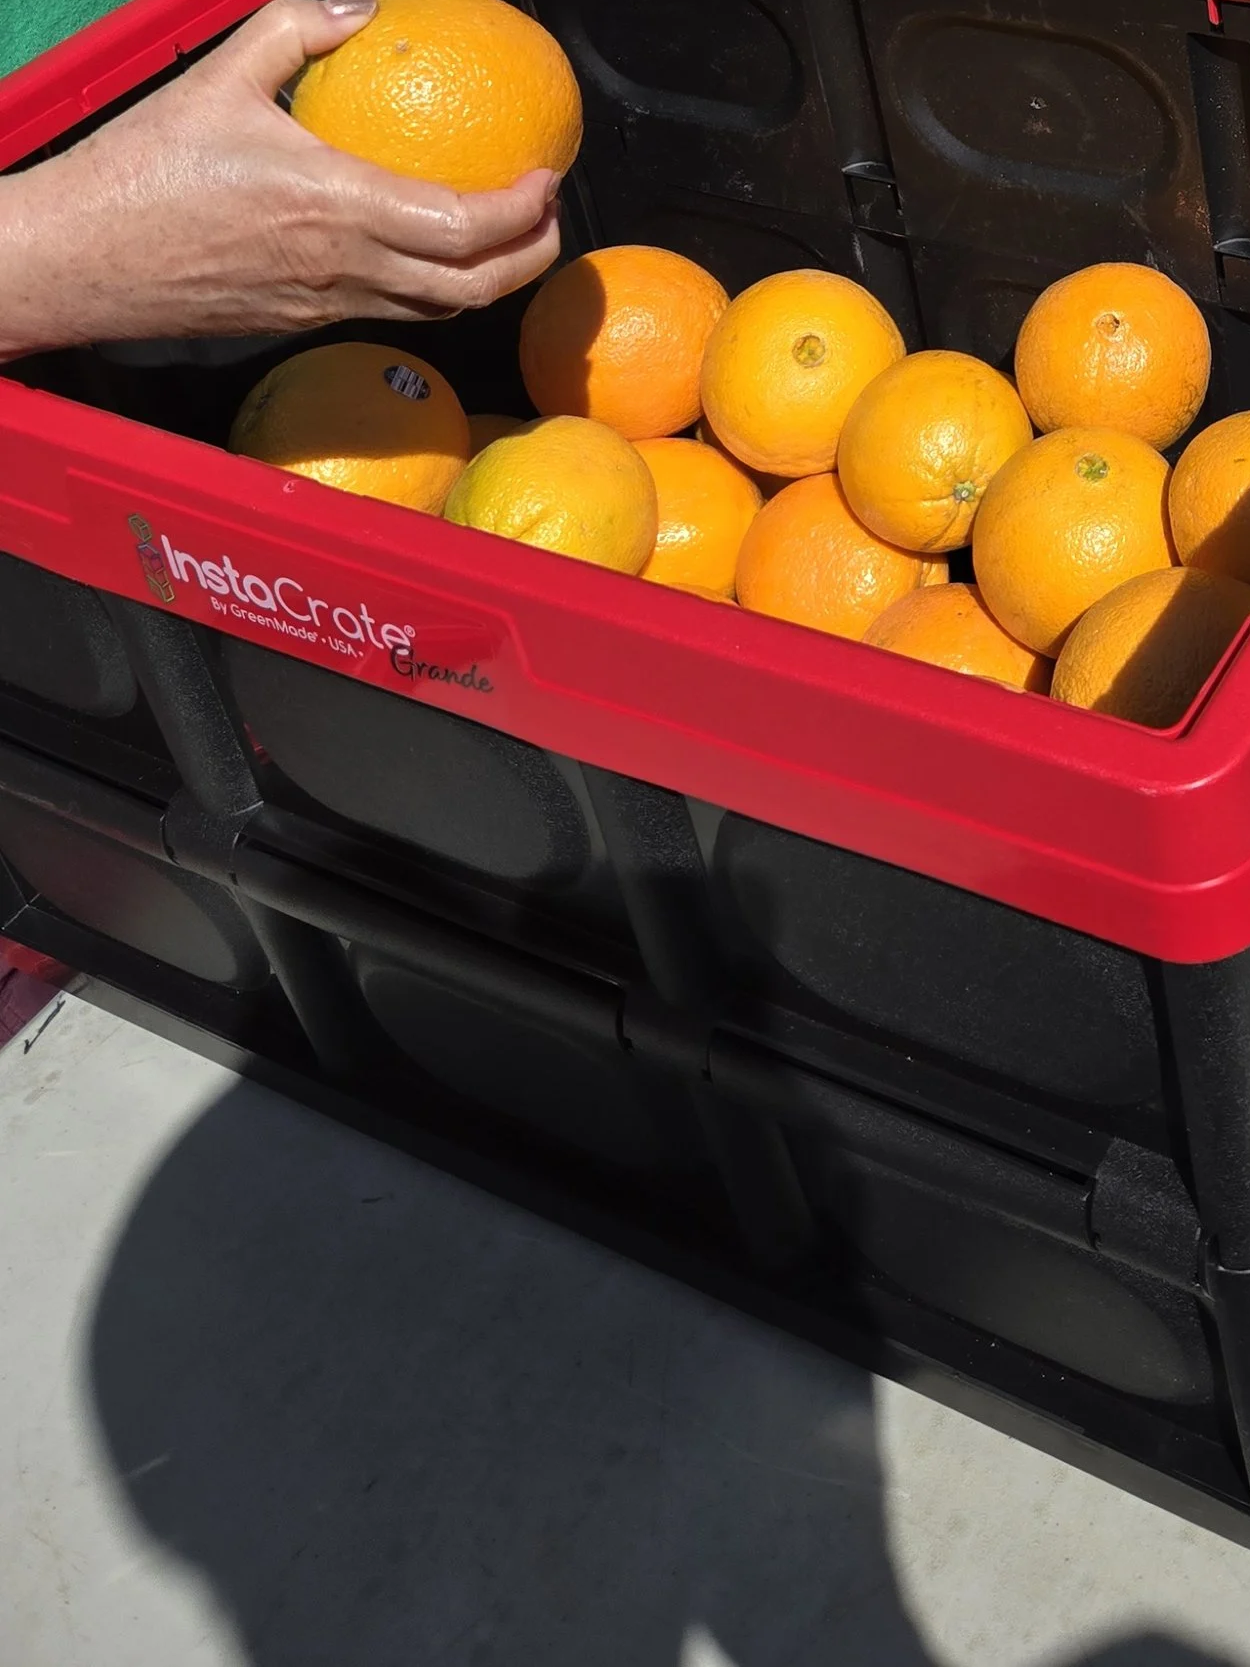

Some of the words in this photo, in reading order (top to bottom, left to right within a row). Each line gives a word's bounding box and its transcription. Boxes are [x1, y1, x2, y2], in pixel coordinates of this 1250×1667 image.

[210, 596, 227, 615] By
[328, 636, 358, 658] USA
[390, 645, 493, 694] Grande
